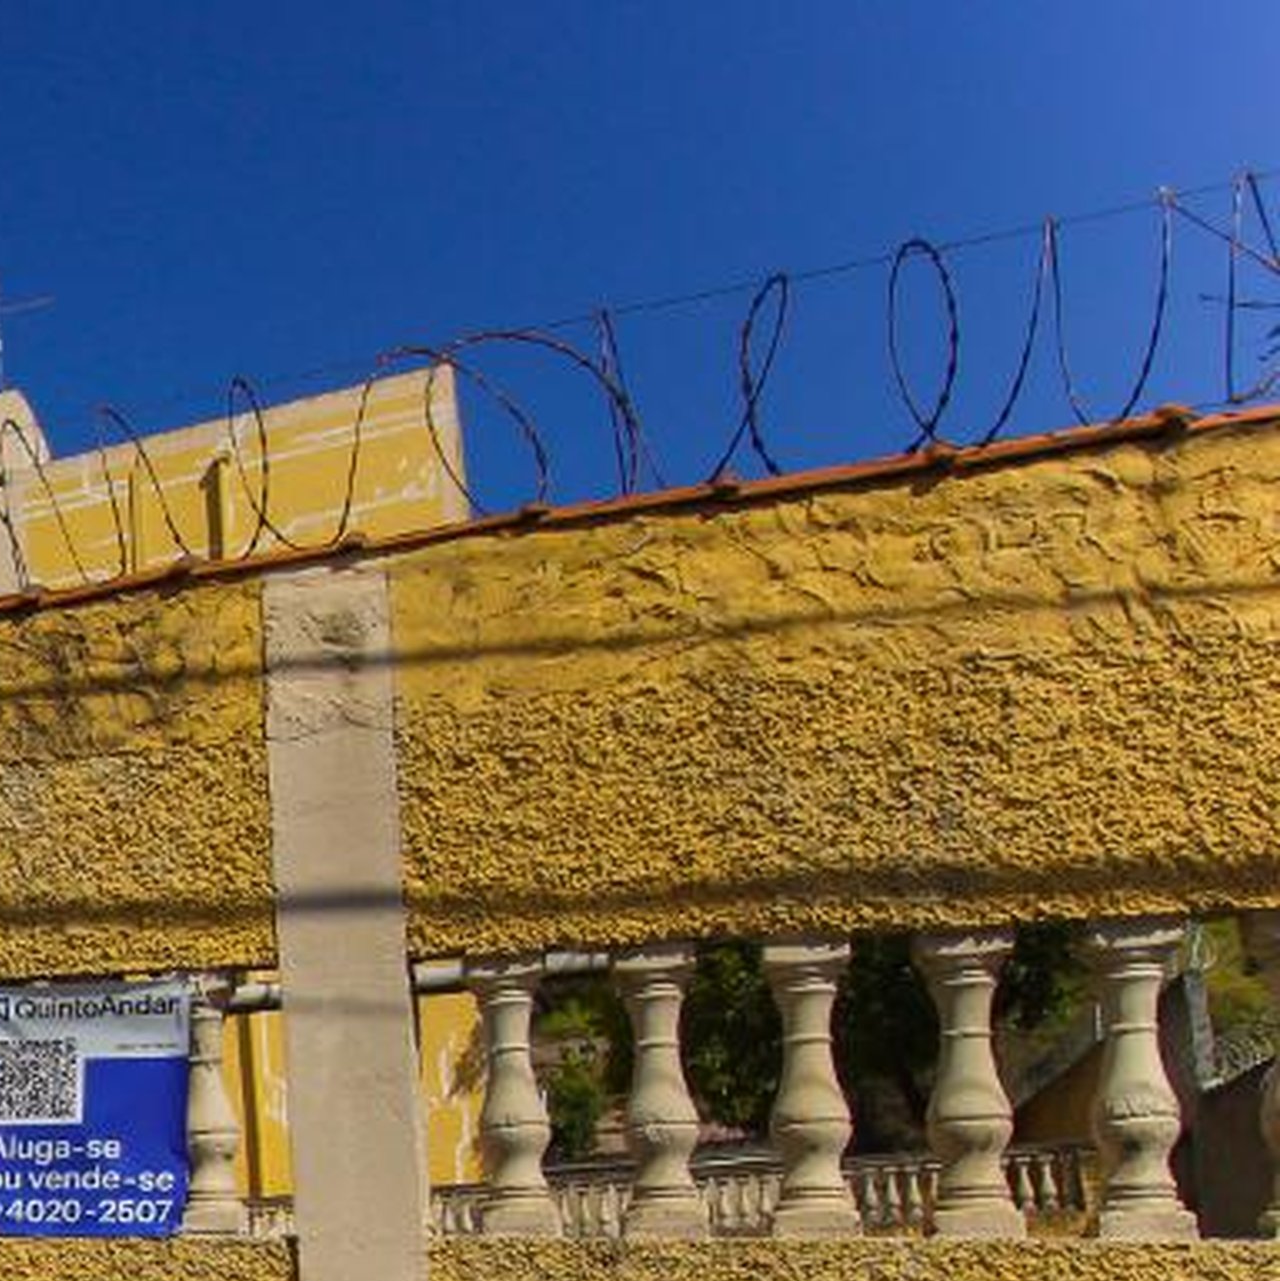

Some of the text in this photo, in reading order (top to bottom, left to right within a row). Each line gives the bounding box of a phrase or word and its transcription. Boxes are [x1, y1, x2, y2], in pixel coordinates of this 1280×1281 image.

[14, 994, 181, 1019] QuintoAndar
[28, 1165, 175, 1192] vende-se
[5, 1199, 173, 1222] 4020-2507
